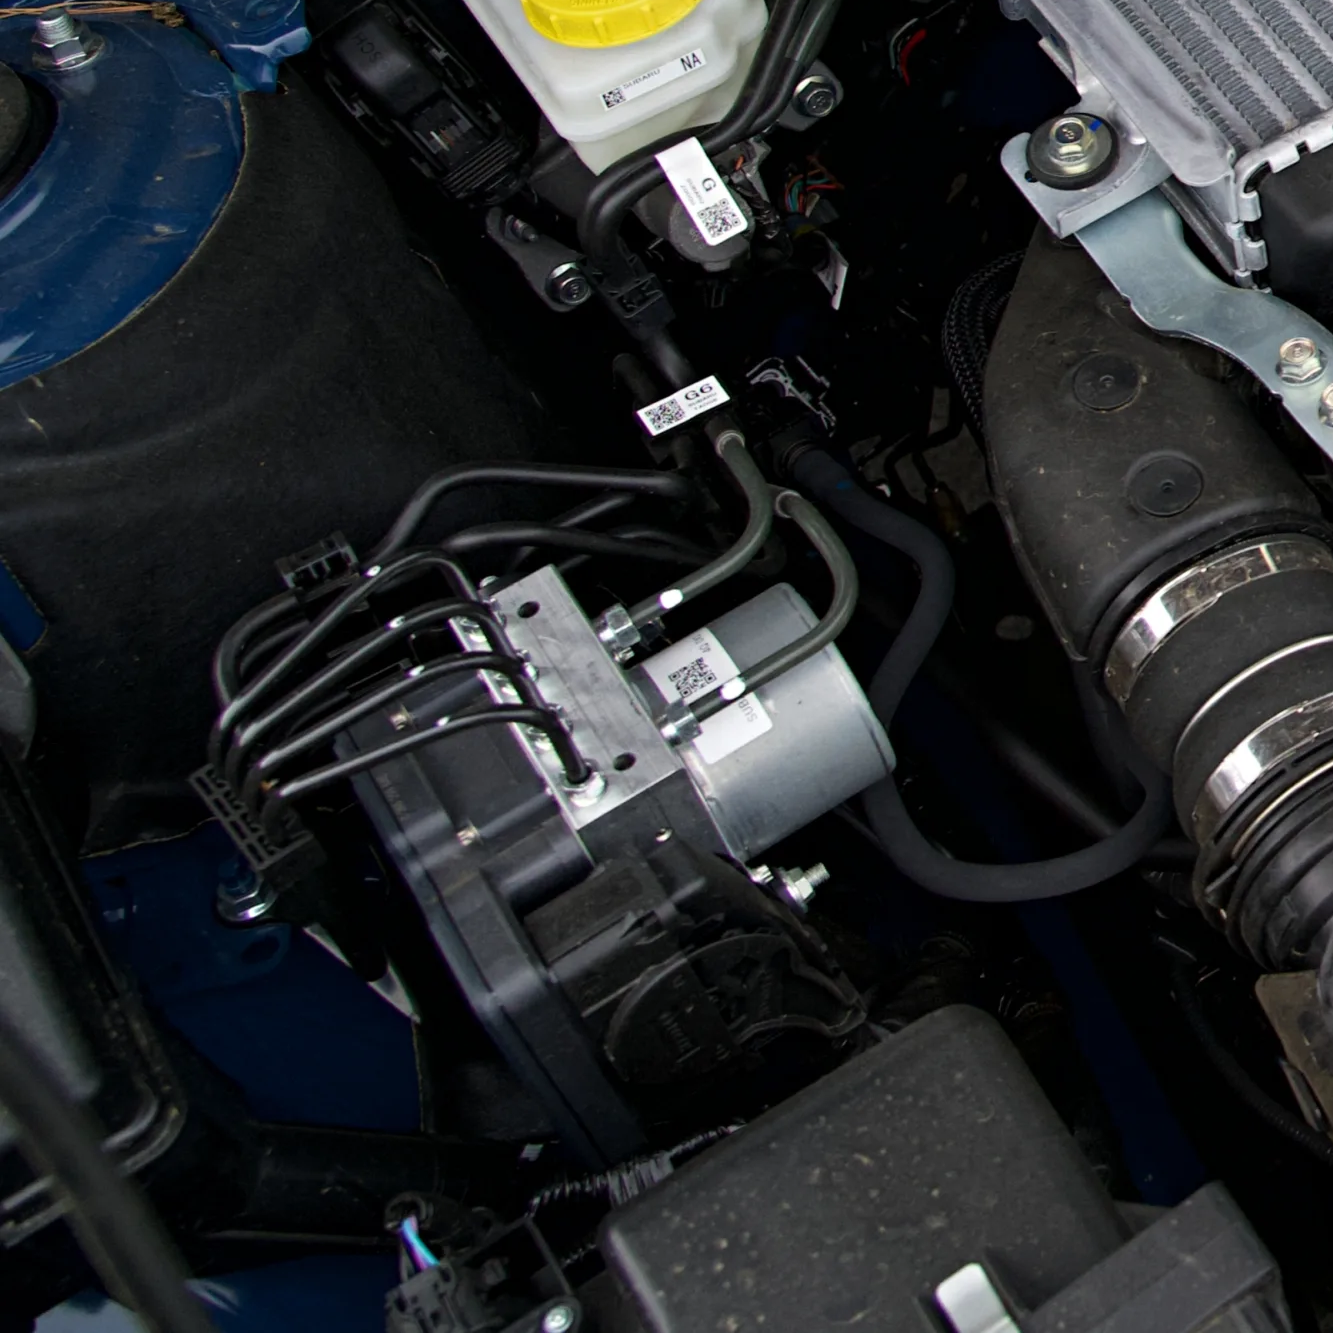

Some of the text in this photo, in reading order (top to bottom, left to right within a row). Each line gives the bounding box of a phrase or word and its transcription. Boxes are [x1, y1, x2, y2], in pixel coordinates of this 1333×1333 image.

[680, 52, 702, 72] NA
[701, 177, 717, 192] G
[684, 383, 713, 401] G6
